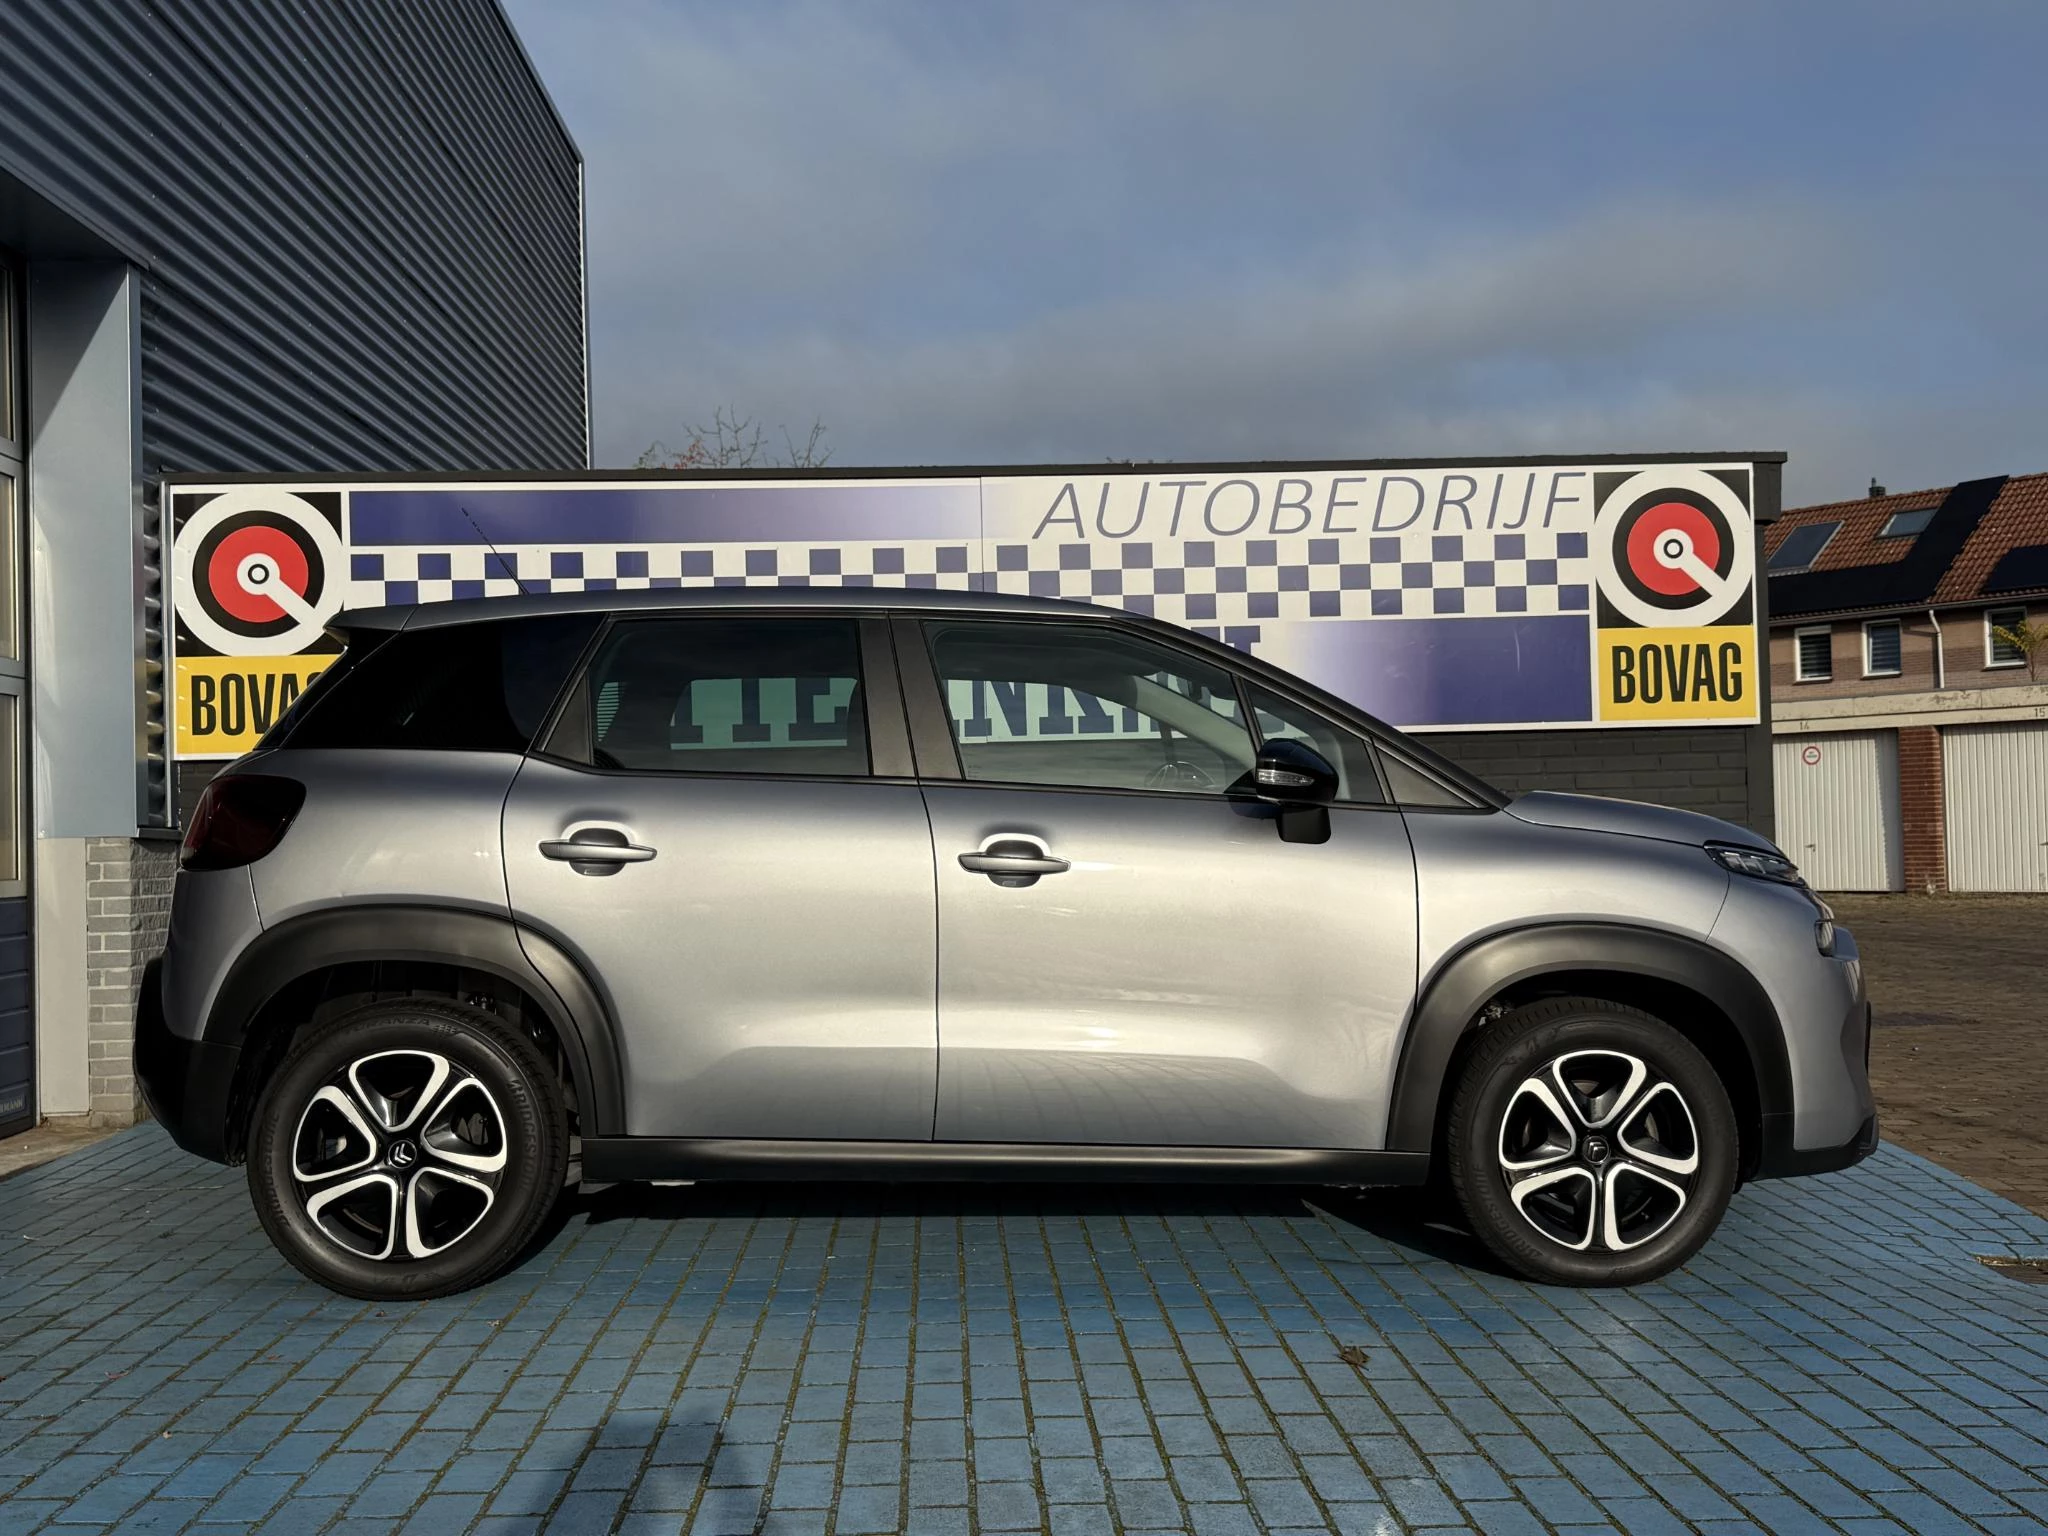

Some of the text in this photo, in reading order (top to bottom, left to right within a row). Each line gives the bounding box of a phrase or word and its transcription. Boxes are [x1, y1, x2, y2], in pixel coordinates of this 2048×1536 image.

[1032, 472, 1586, 540] AUTOBEDRIJF
[191, 672, 324, 736] BOVA
[1612, 642, 1743, 704] BOVAG
[2034, 707, 2046, 718] 15
